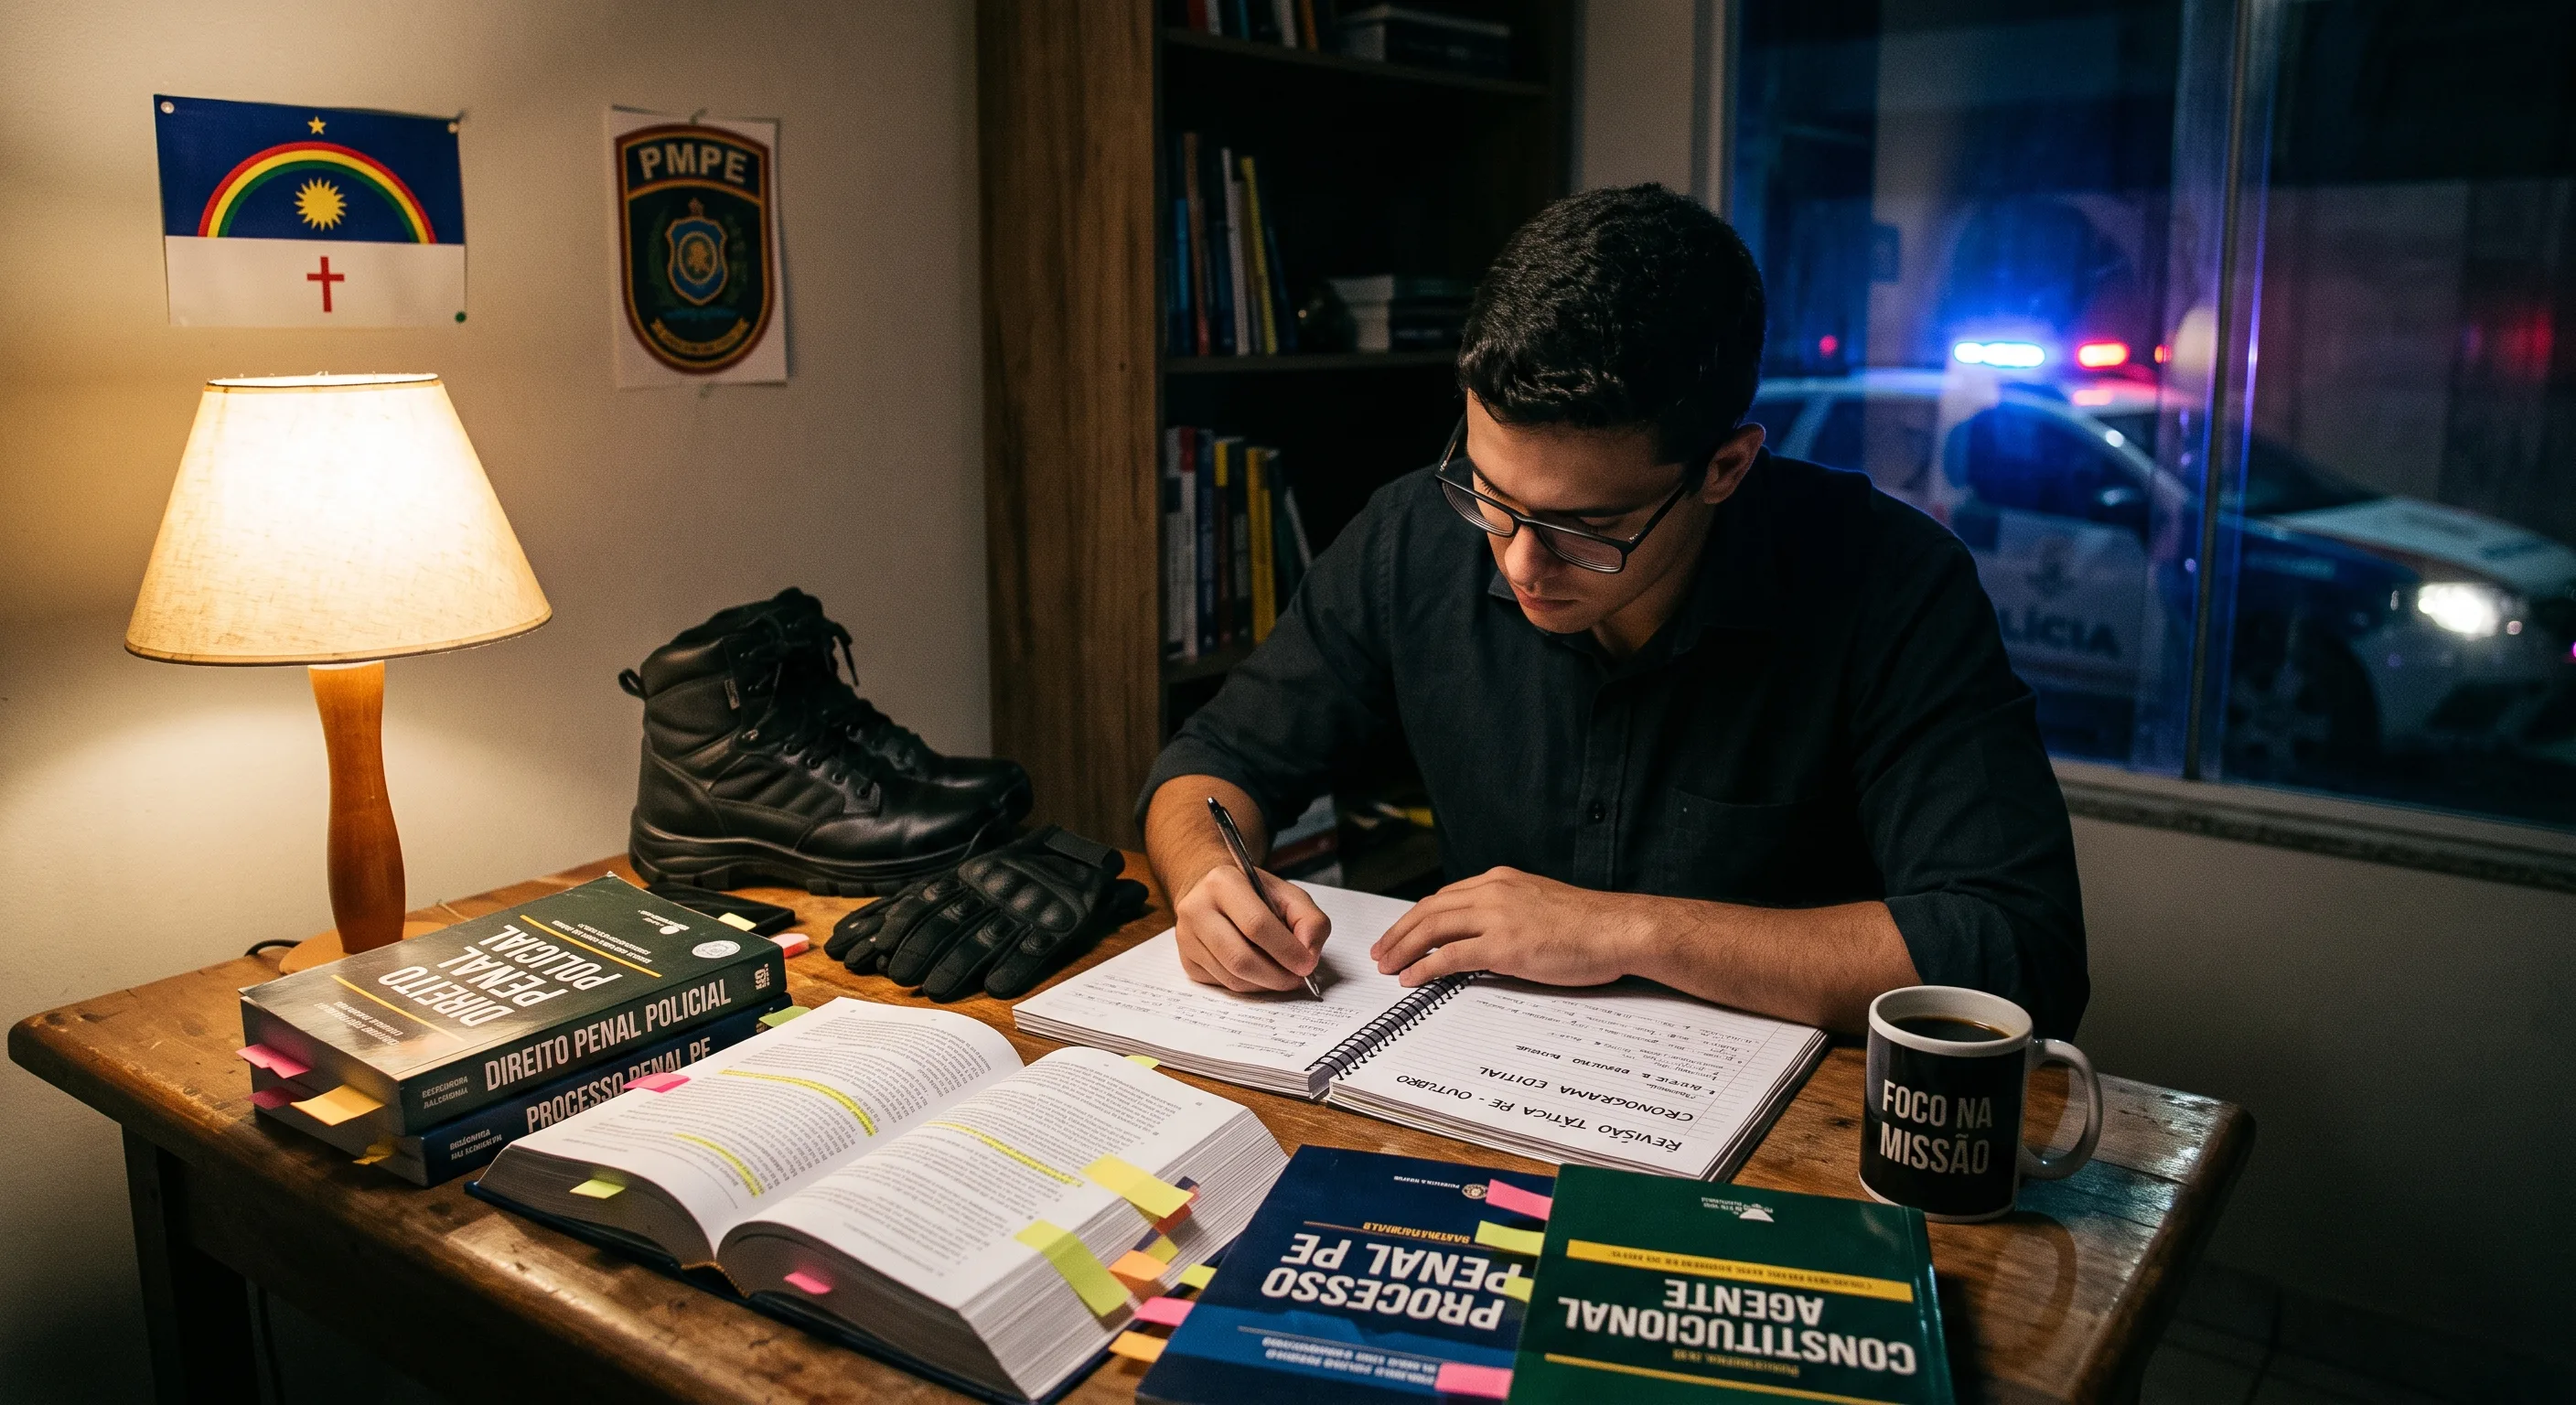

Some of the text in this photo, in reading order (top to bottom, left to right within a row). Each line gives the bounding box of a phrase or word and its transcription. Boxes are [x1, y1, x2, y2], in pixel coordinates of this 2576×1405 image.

[639, 143, 748, 185] PMPE
[1998, 606, 2122, 658] LÍCIA
[436, 945, 569, 1007] PENAL
[478, 924, 624, 991] POLICIAL
[378, 966, 516, 1027] DIREITO
[485, 1035, 569, 1091] DIREITO
[574, 1011, 642, 1058] PENAL
[645, 978, 732, 1033] POLICIAL
[526, 1072, 625, 1133] PROCESSO
[1479, 1066, 1695, 1122] CRONOGRAMA EDITIAL
[1523, 1105, 1587, 1128] TÁTICA
[1882, 1078, 1993, 1130] FOCO NA
[1879, 1121, 1991, 1175] MISSÃO
[1281, 1233, 1352, 1271] PE
[1365, 1242, 1523, 1294] PENAL
[1261, 1267, 1507, 1331] PROCESSO
[1661, 1278, 1826, 1327] AGENTE
[1557, 1295, 1917, 1376] CONSTITUCIONAL
